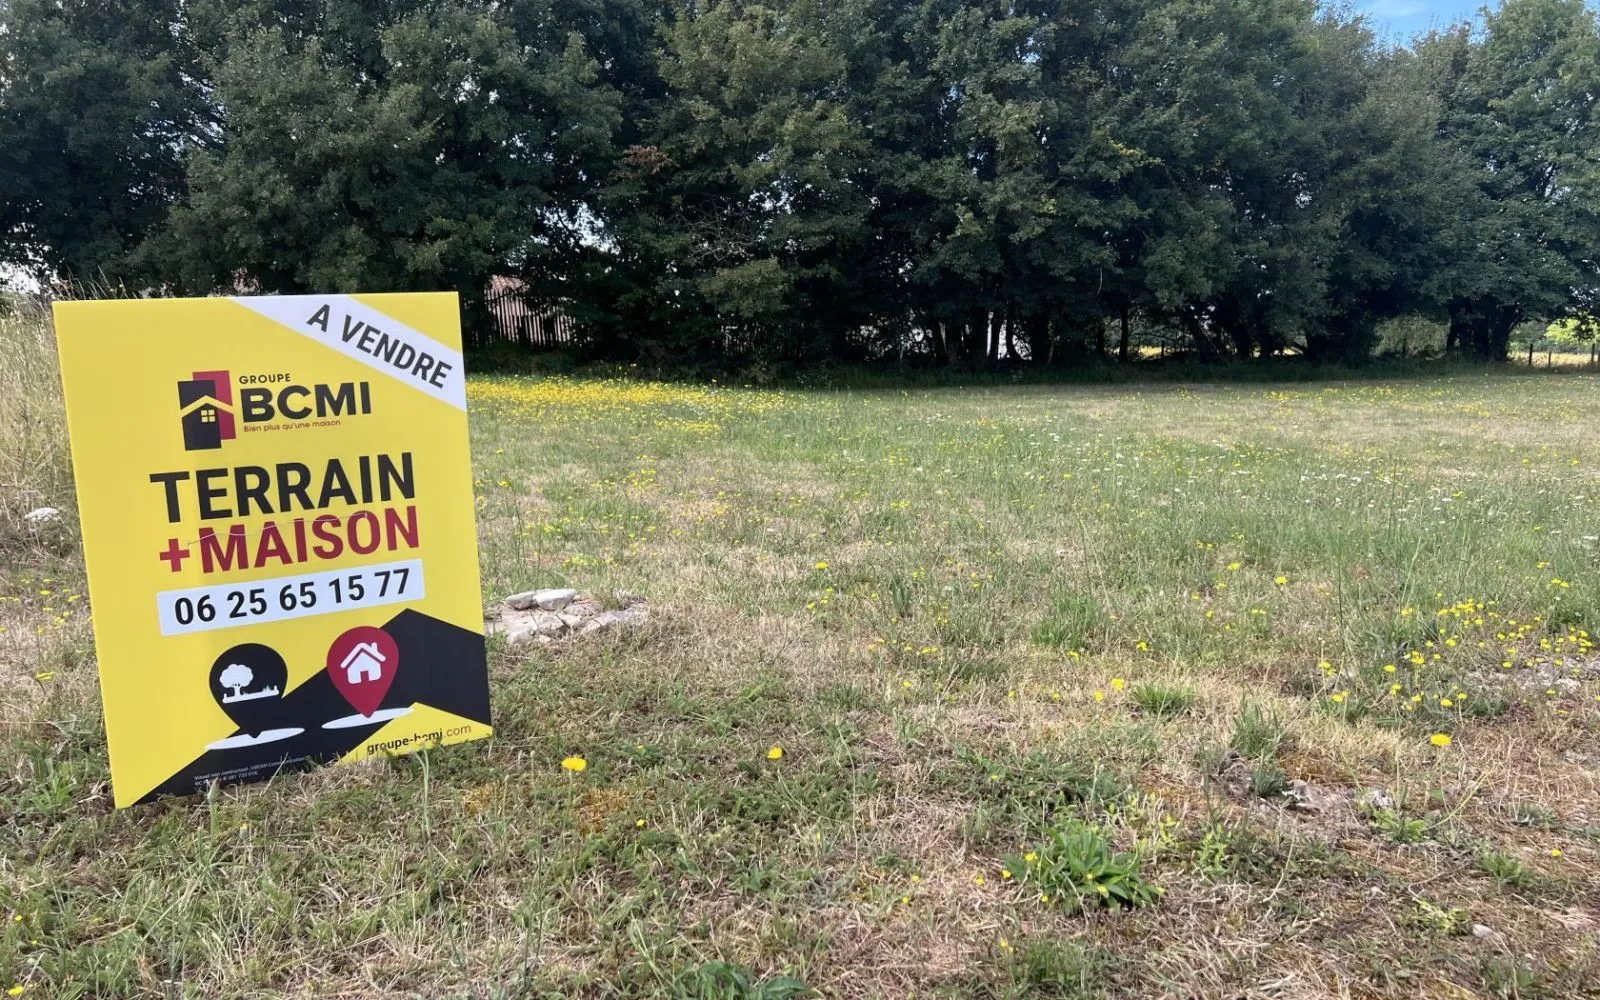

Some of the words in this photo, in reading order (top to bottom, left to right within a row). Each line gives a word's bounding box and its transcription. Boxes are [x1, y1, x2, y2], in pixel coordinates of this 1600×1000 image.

[306, 304, 331, 333] A
[341, 314, 453, 389] VENDRE
[239, 373, 292, 385] GROUPE
[239, 381, 372, 423] BCMI
[243, 424, 262, 433] Bien
[263, 422, 281, 432] plus
[282, 421, 311, 431] qu'une
[312, 419, 341, 428] maison
[148, 451, 416, 524] TERRAIN
[174, 594, 216, 625] 06
[227, 588, 268, 619] 25
[278, 581, 317, 611] 65
[328, 574, 365, 604] 15
[374, 567, 410, 597] 77
